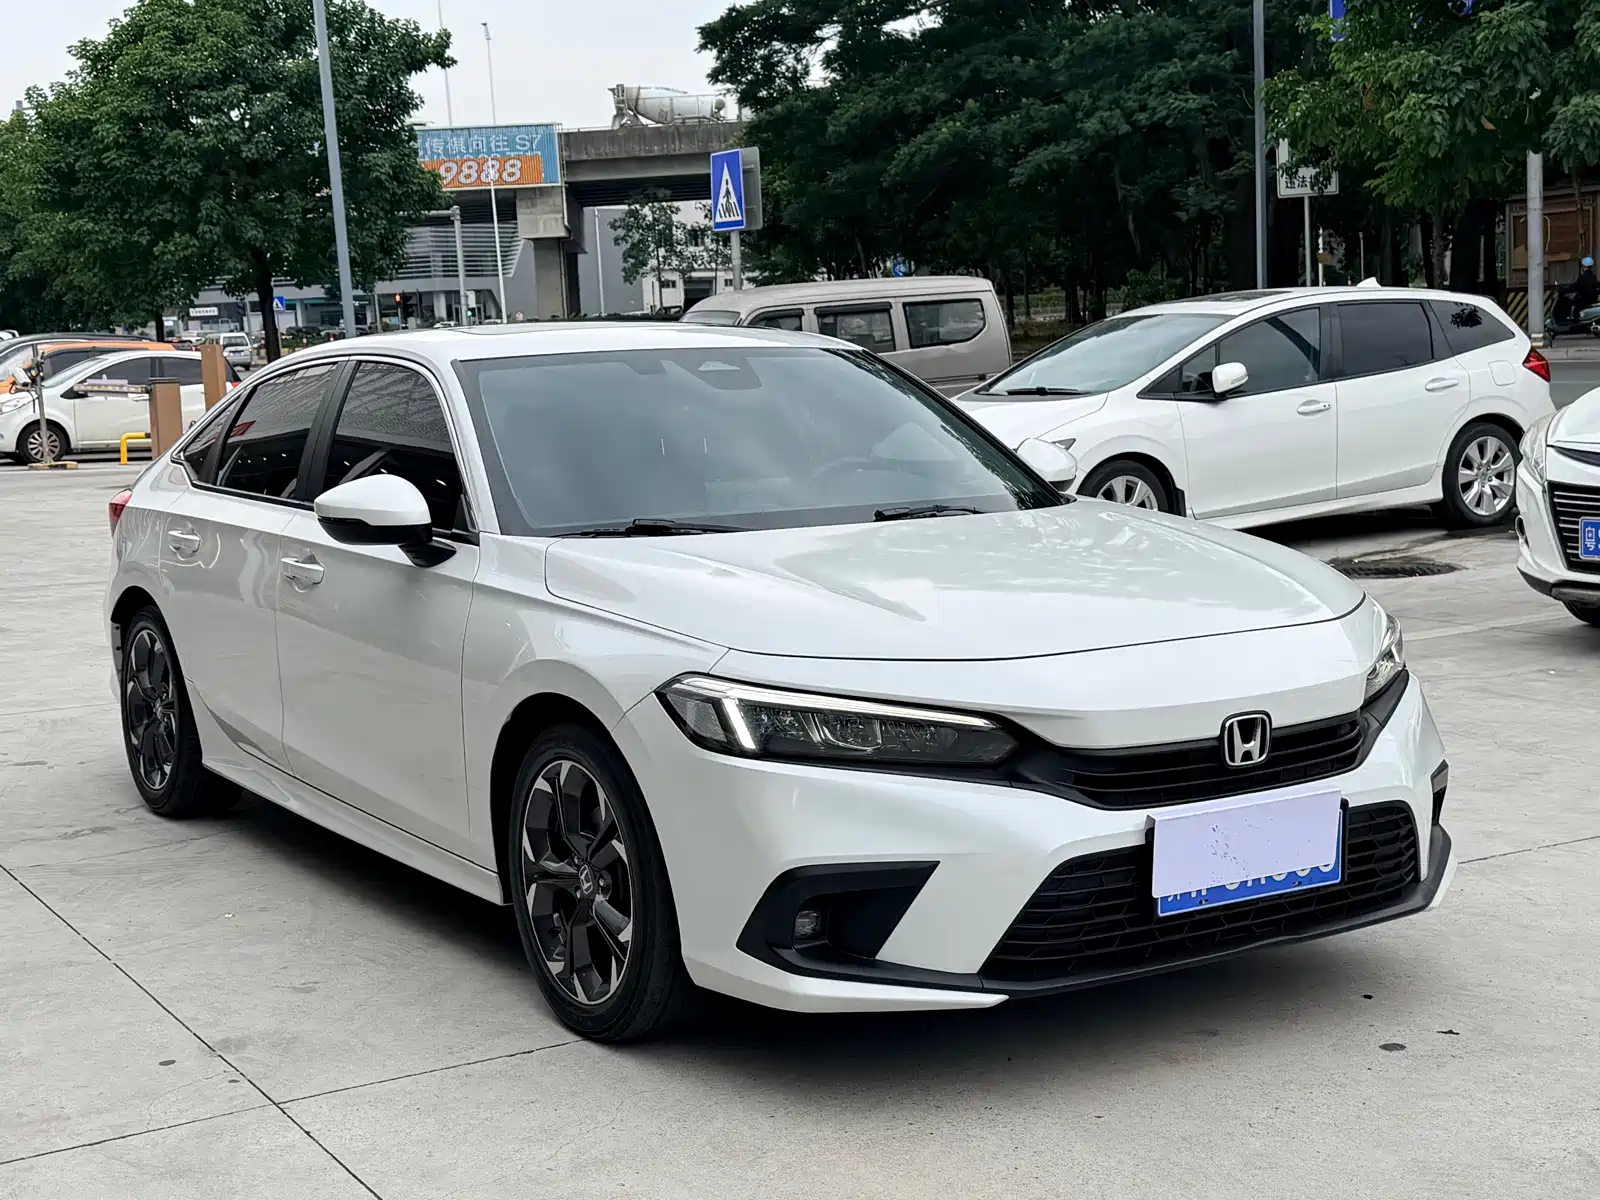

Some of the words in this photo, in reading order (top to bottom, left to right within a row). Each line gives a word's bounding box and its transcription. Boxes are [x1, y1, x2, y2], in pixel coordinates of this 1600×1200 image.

[417, 134, 510, 155] 传祺向往
[515, 134, 542, 151] S7
[438, 158, 522, 185] 9888
[1584, 525, 1600, 551] 粤
